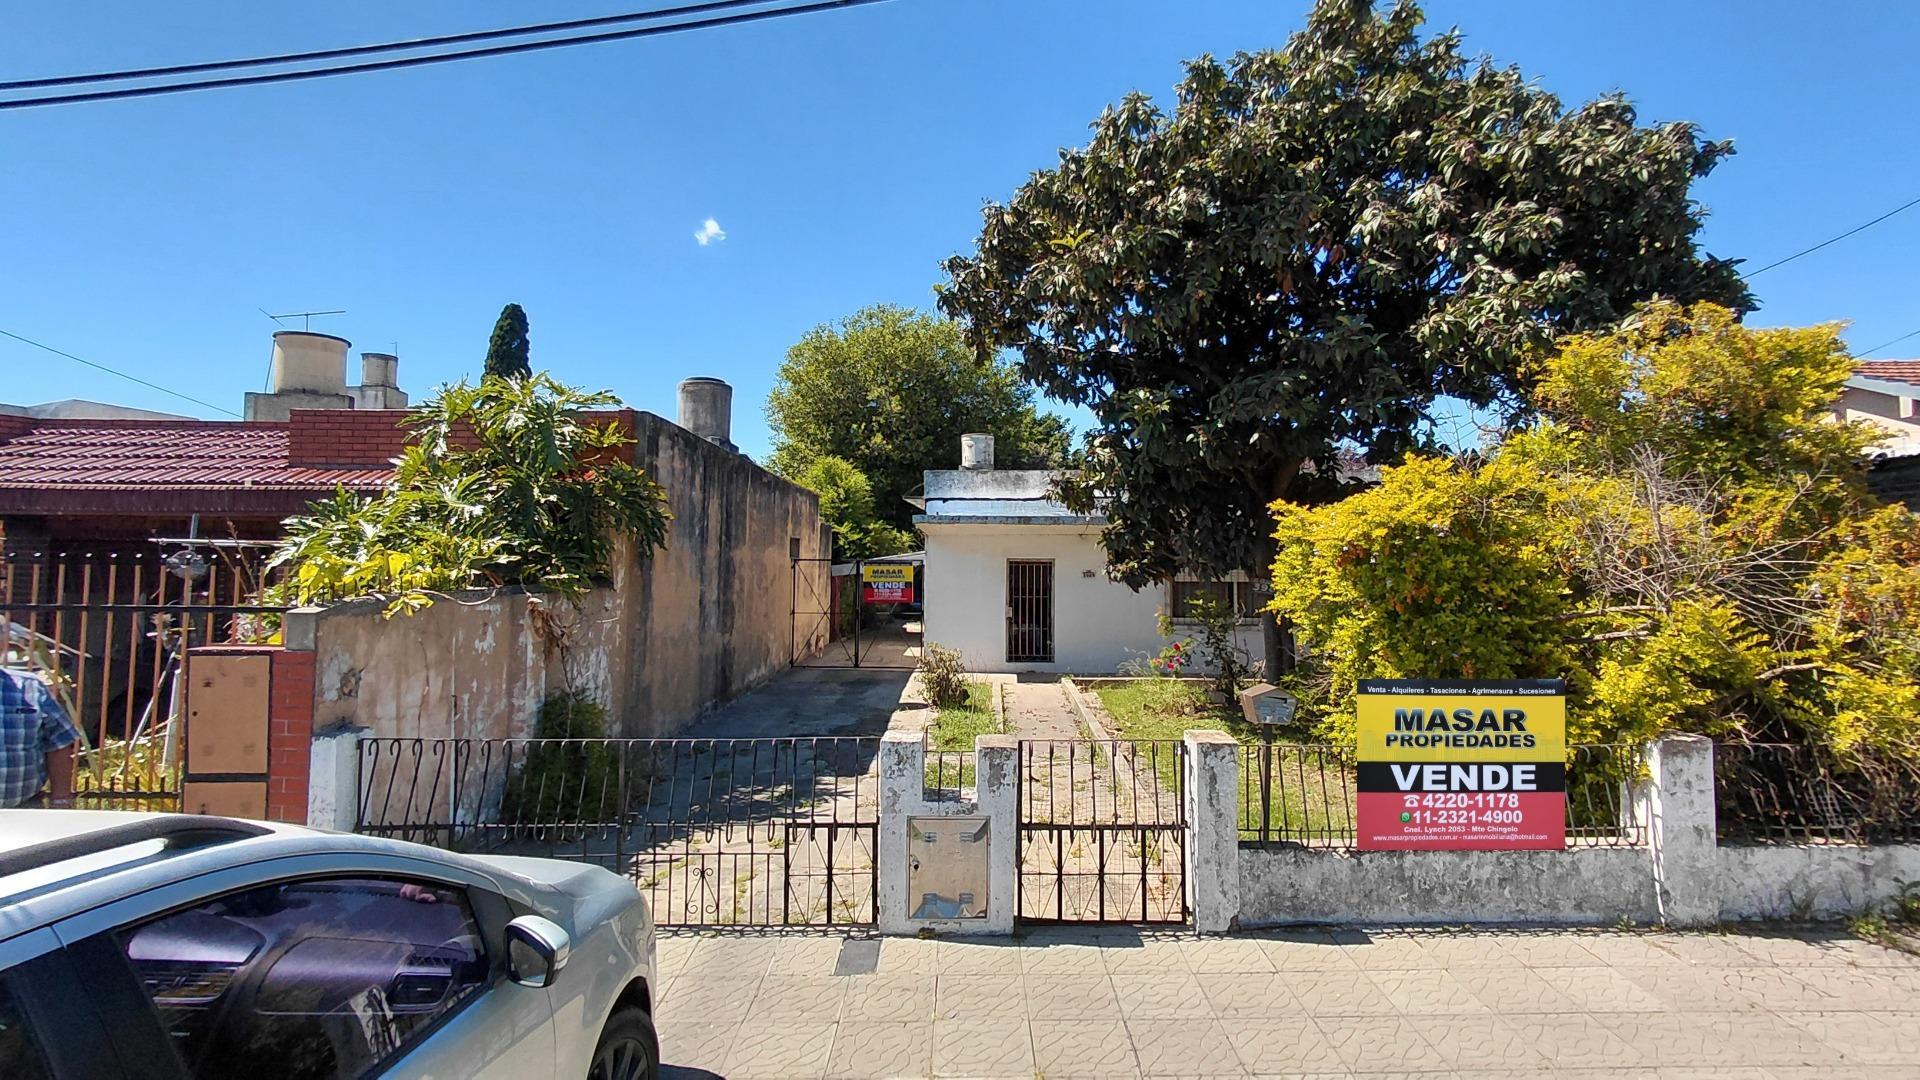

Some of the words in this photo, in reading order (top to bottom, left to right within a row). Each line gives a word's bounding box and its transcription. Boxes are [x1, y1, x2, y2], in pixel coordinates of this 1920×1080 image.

[1391, 686, 1425, 694] Alquileres
[1472, 687, 1514, 695] Agrimensura
[1518, 687, 1556, 695] Sucesiones
[1394, 708, 1526, 732] MASAR
[1385, 734, 1536, 748] PROPIEDADES
[1390, 764, 1537, 791] VENDE
[1422, 793, 1519, 808] 4220-1178
[1413, 810, 1523, 824] 11-2321-4900
[1424, 826, 1446, 834] Lynch
